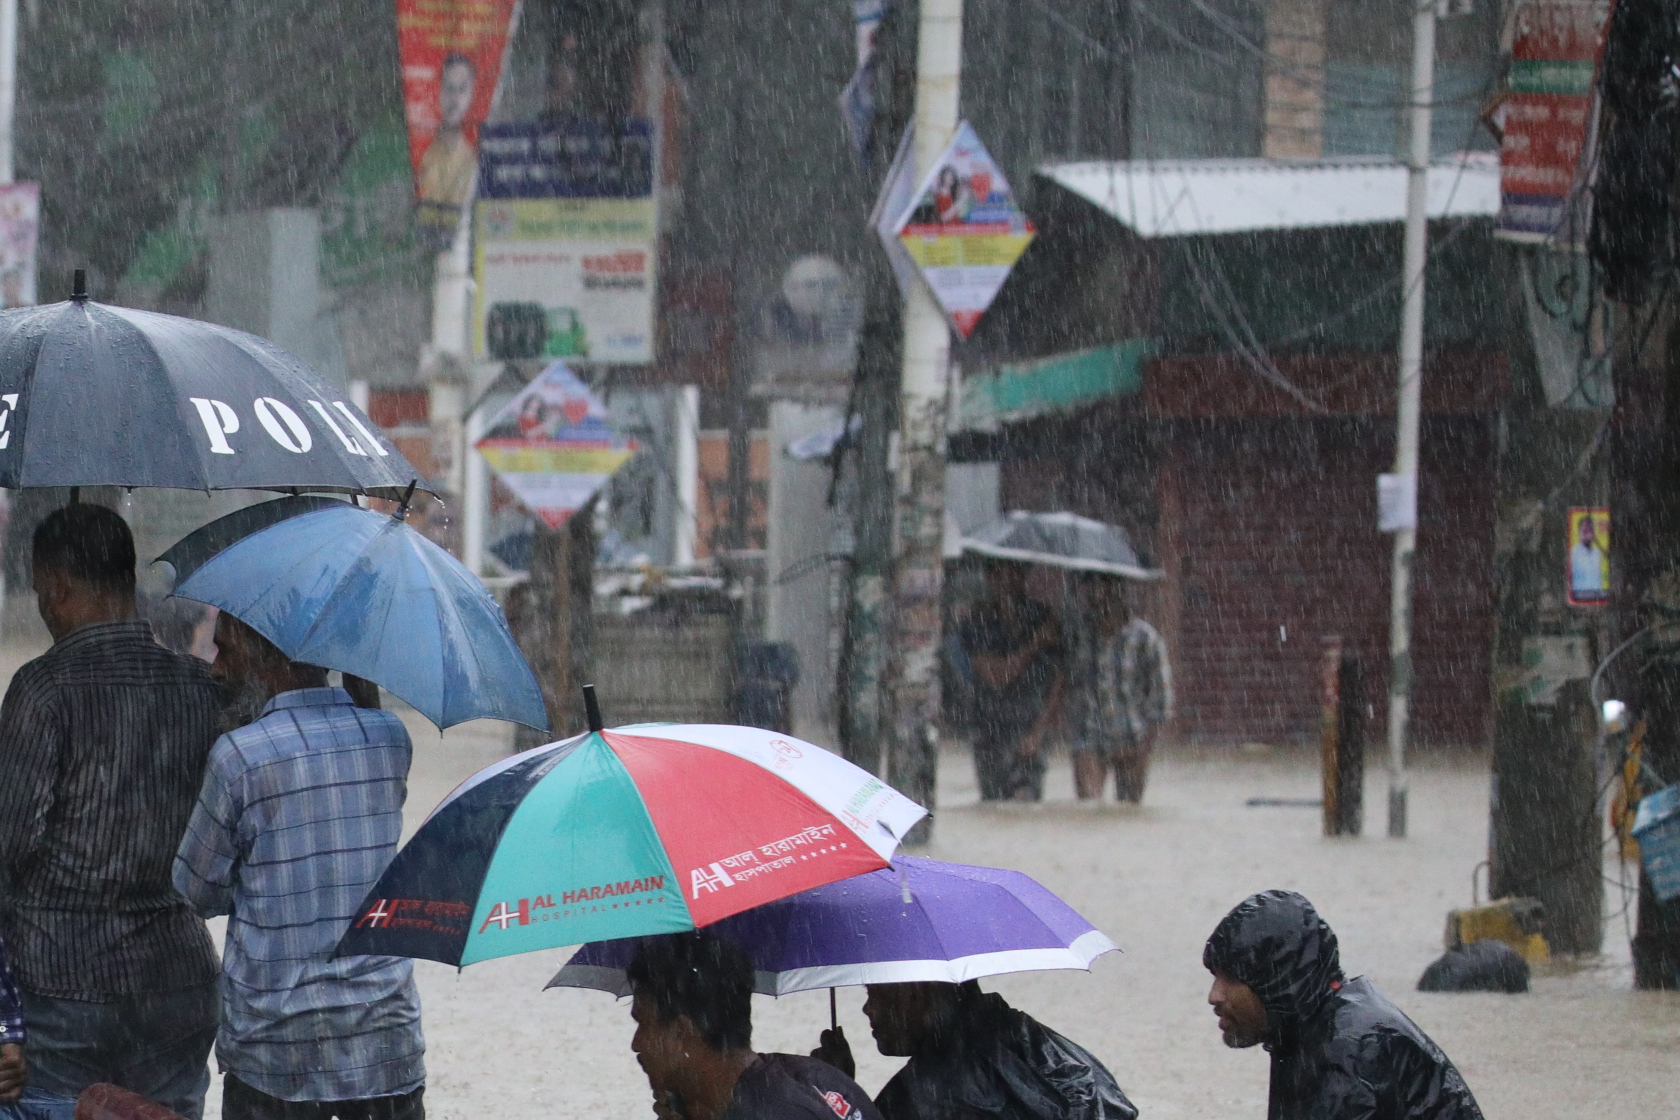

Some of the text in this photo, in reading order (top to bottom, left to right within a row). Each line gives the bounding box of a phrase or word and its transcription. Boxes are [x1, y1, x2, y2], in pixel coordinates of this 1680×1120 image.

[757, 824, 837, 857] হারামাইন
[732, 855, 797, 881] হাসপাতাল
[531, 875, 665, 911] AL HARAMAIN
[530, 905, 607, 923] HOSPITAL
